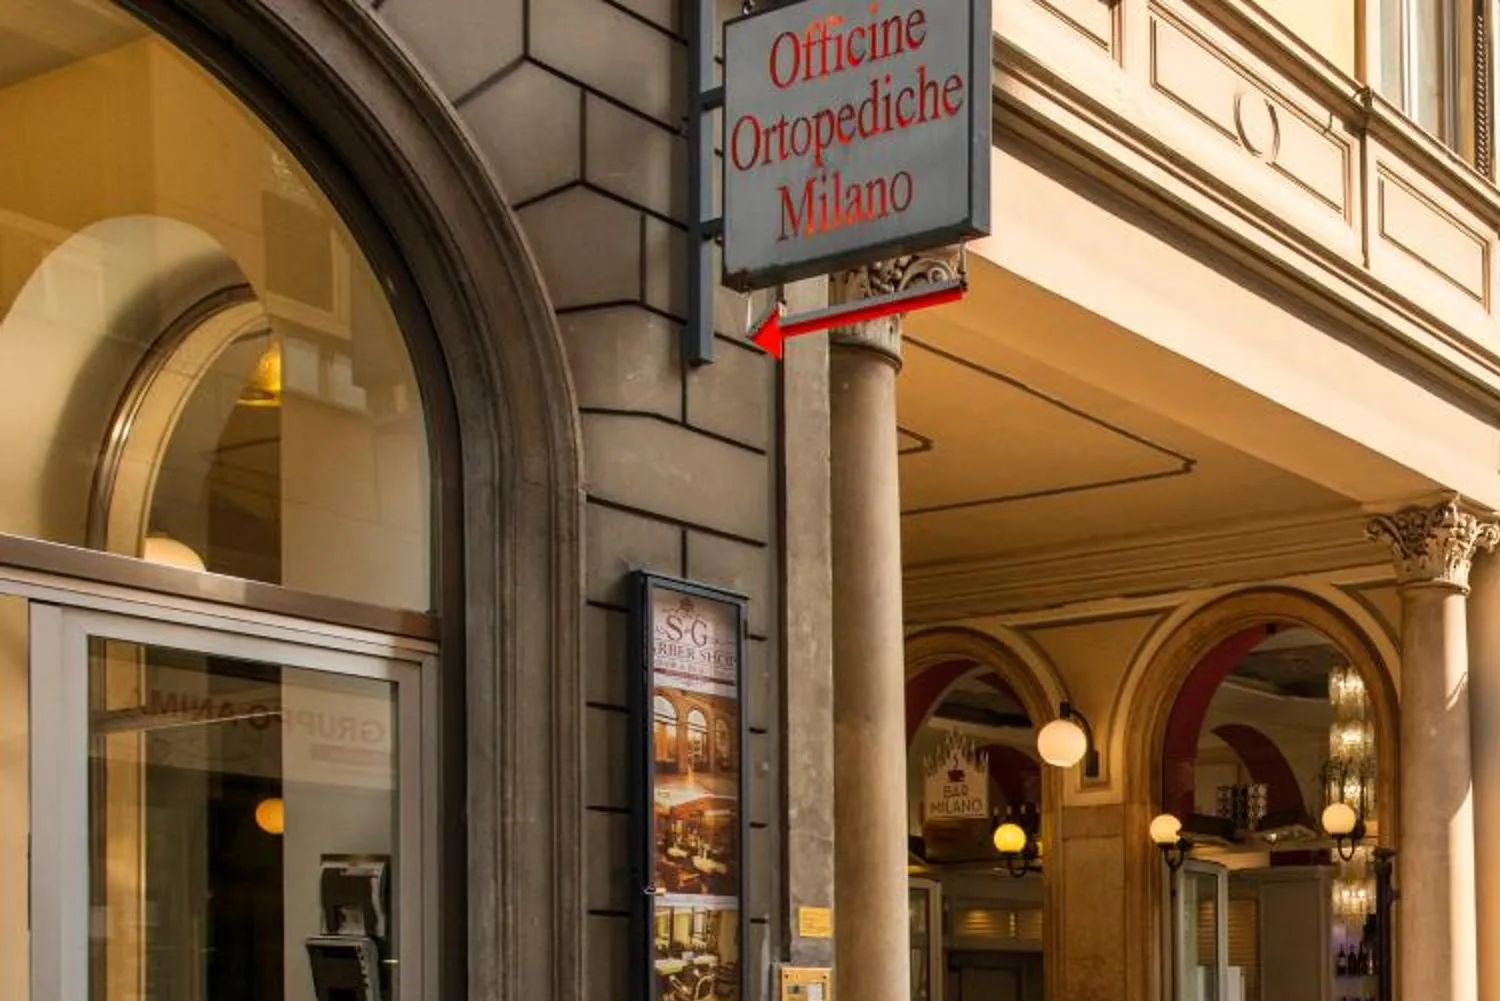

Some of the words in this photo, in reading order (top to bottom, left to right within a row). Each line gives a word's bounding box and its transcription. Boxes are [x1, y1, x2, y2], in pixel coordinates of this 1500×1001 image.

[769, 1, 927, 89] Officine
[731, 65, 963, 172] Ortopediche
[777, 170, 913, 242] Milano
[928, 798, 983, 815] MILANO
